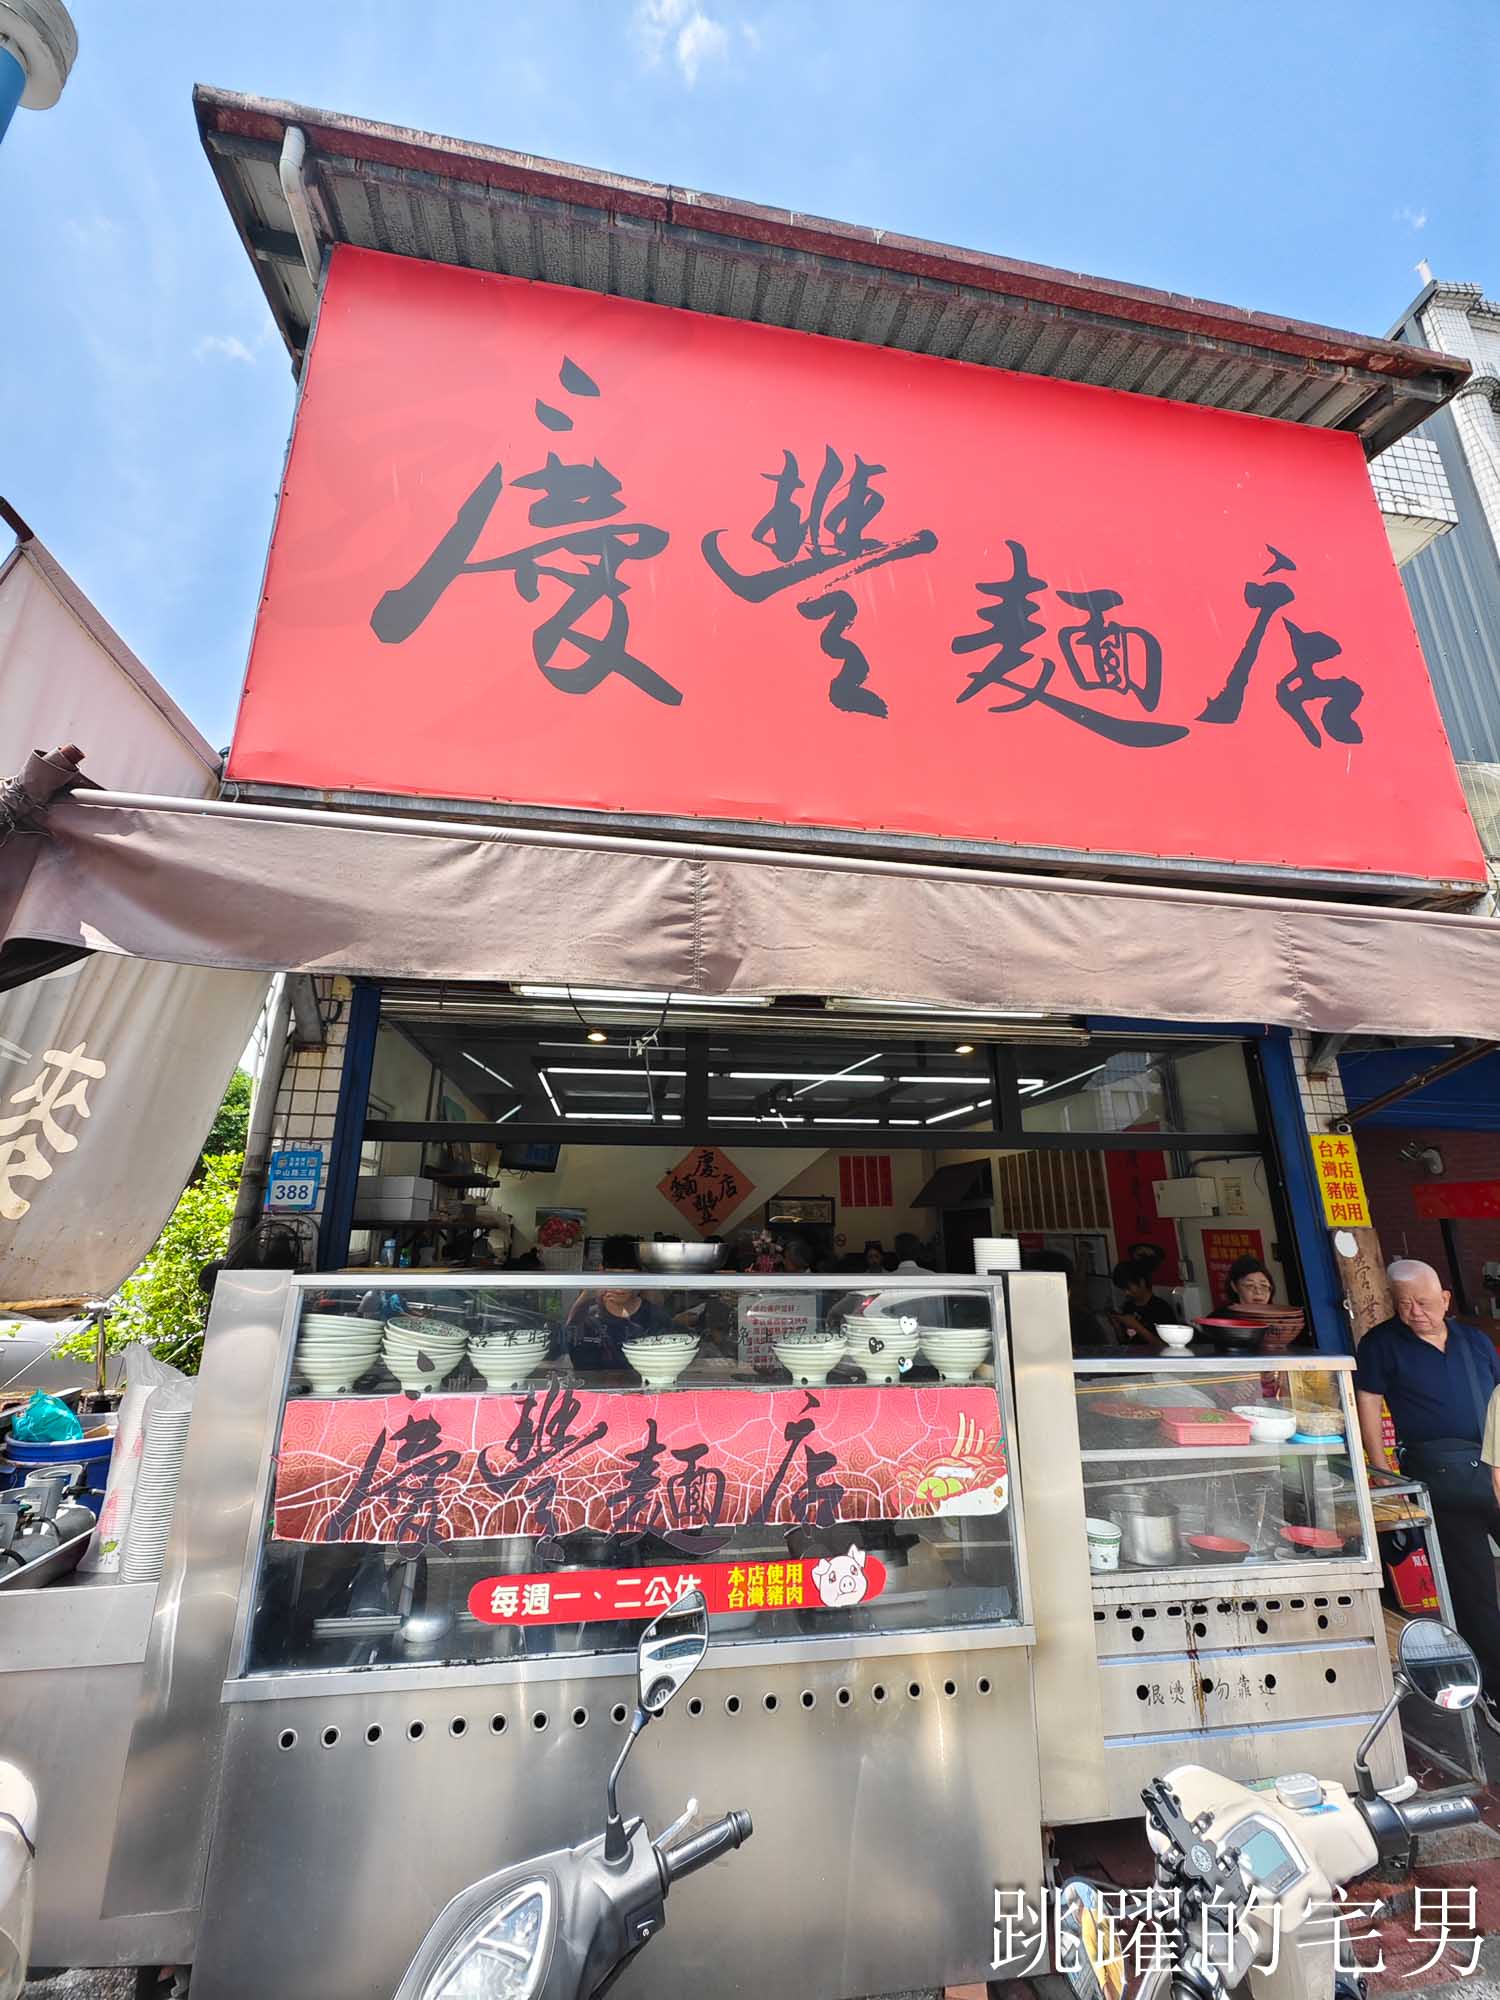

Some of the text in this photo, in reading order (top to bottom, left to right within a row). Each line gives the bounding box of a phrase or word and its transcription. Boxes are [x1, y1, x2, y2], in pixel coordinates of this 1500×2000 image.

[275, 1185, 309, 1200] 388
[1317, 1140, 1347, 1221] 台灣豬肉
[1333, 1140, 1363, 1221] 本店使用
[727, 1563, 803, 1587] 本店使用
[489, 1574, 702, 1618] 每週一、二公休
[727, 1584, 803, 1608] 台灣豬肉
[1147, 1673, 1277, 1706] 很燙勿靠近
